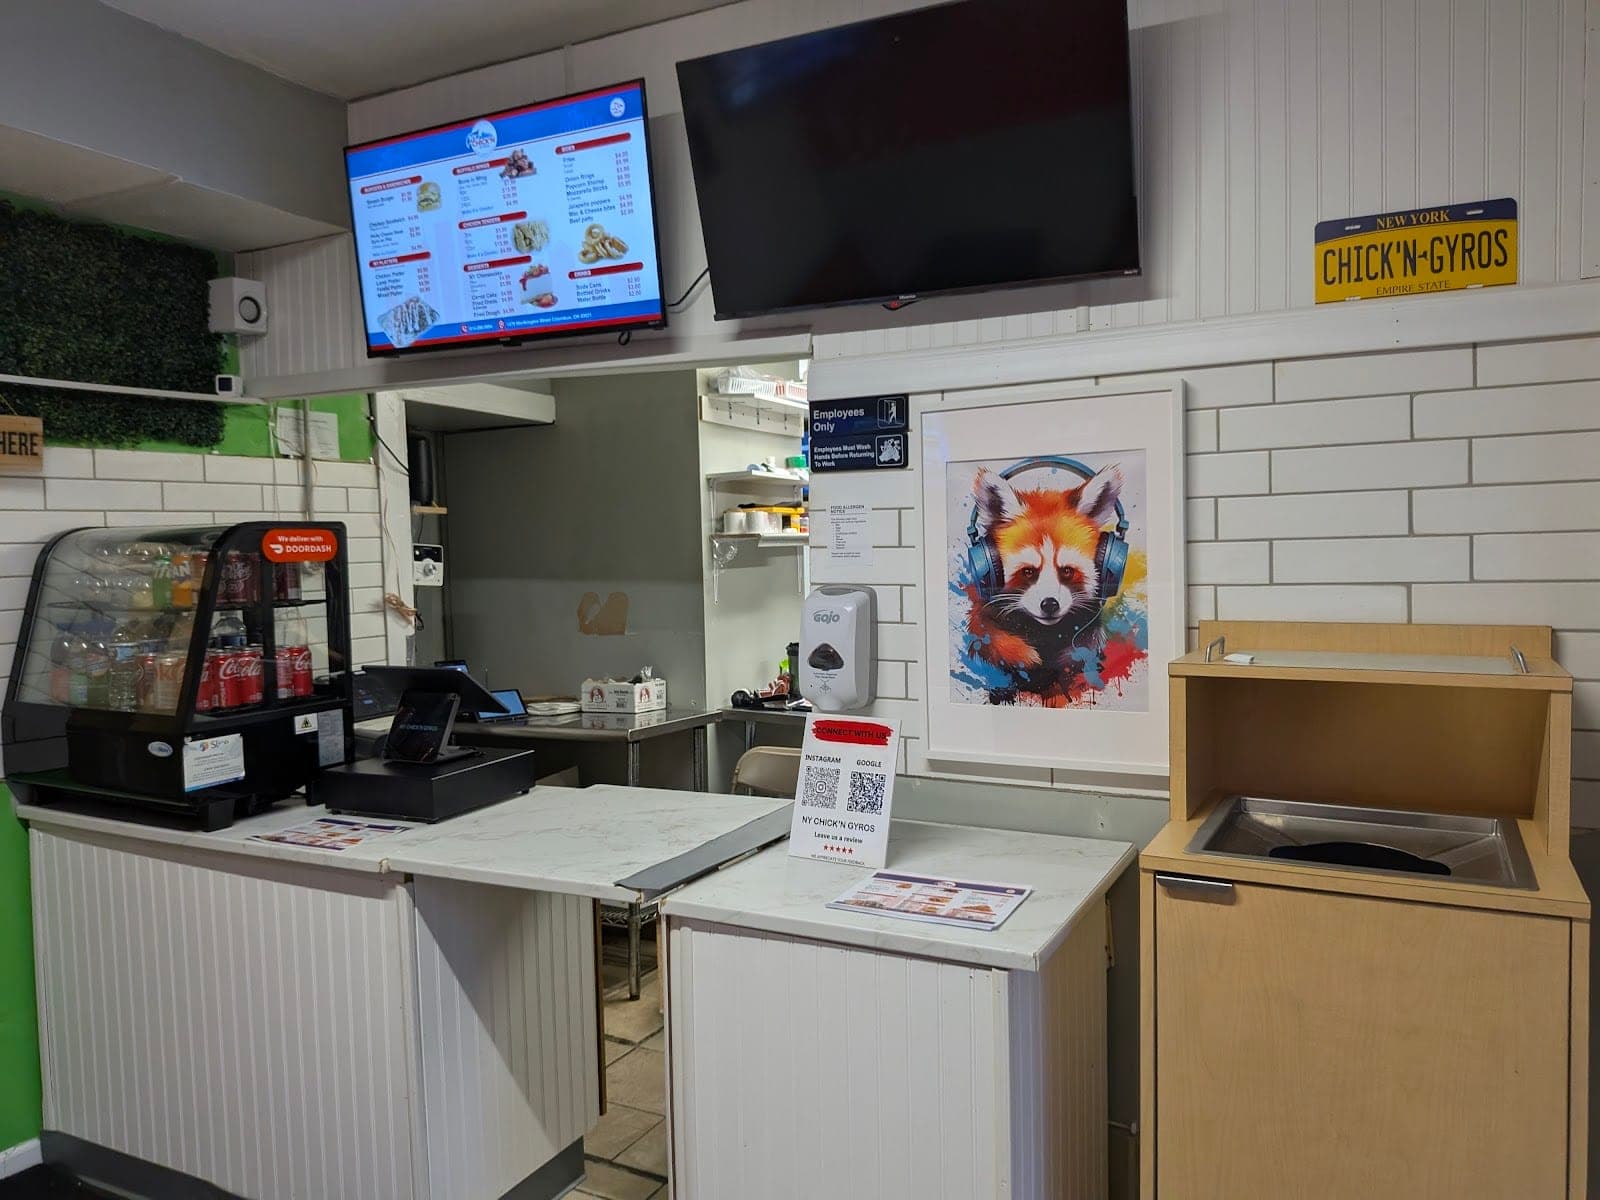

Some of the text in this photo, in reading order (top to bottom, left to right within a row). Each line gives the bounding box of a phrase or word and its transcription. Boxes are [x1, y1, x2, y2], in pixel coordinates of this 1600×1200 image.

[1376, 209, 1450, 230] NEW YORK
[1376, 280, 1450, 295] EMPIRE STATE
[813, 408, 865, 420] Employees
[813, 422, 835, 433] Only
[814, 445, 841, 453] Employees
[849, 451, 875, 459] Returning
[286, 545, 331, 553] DOORDASH
[816, 726, 852, 736] CONNECT
[854, 730, 873, 738] WITH
[805, 754, 841, 763] INSTAGRAM
[802, 816, 875, 833] NY CHICK'N GYROS
[814, 832, 830, 840] Leave
[844, 836, 863, 844] review
